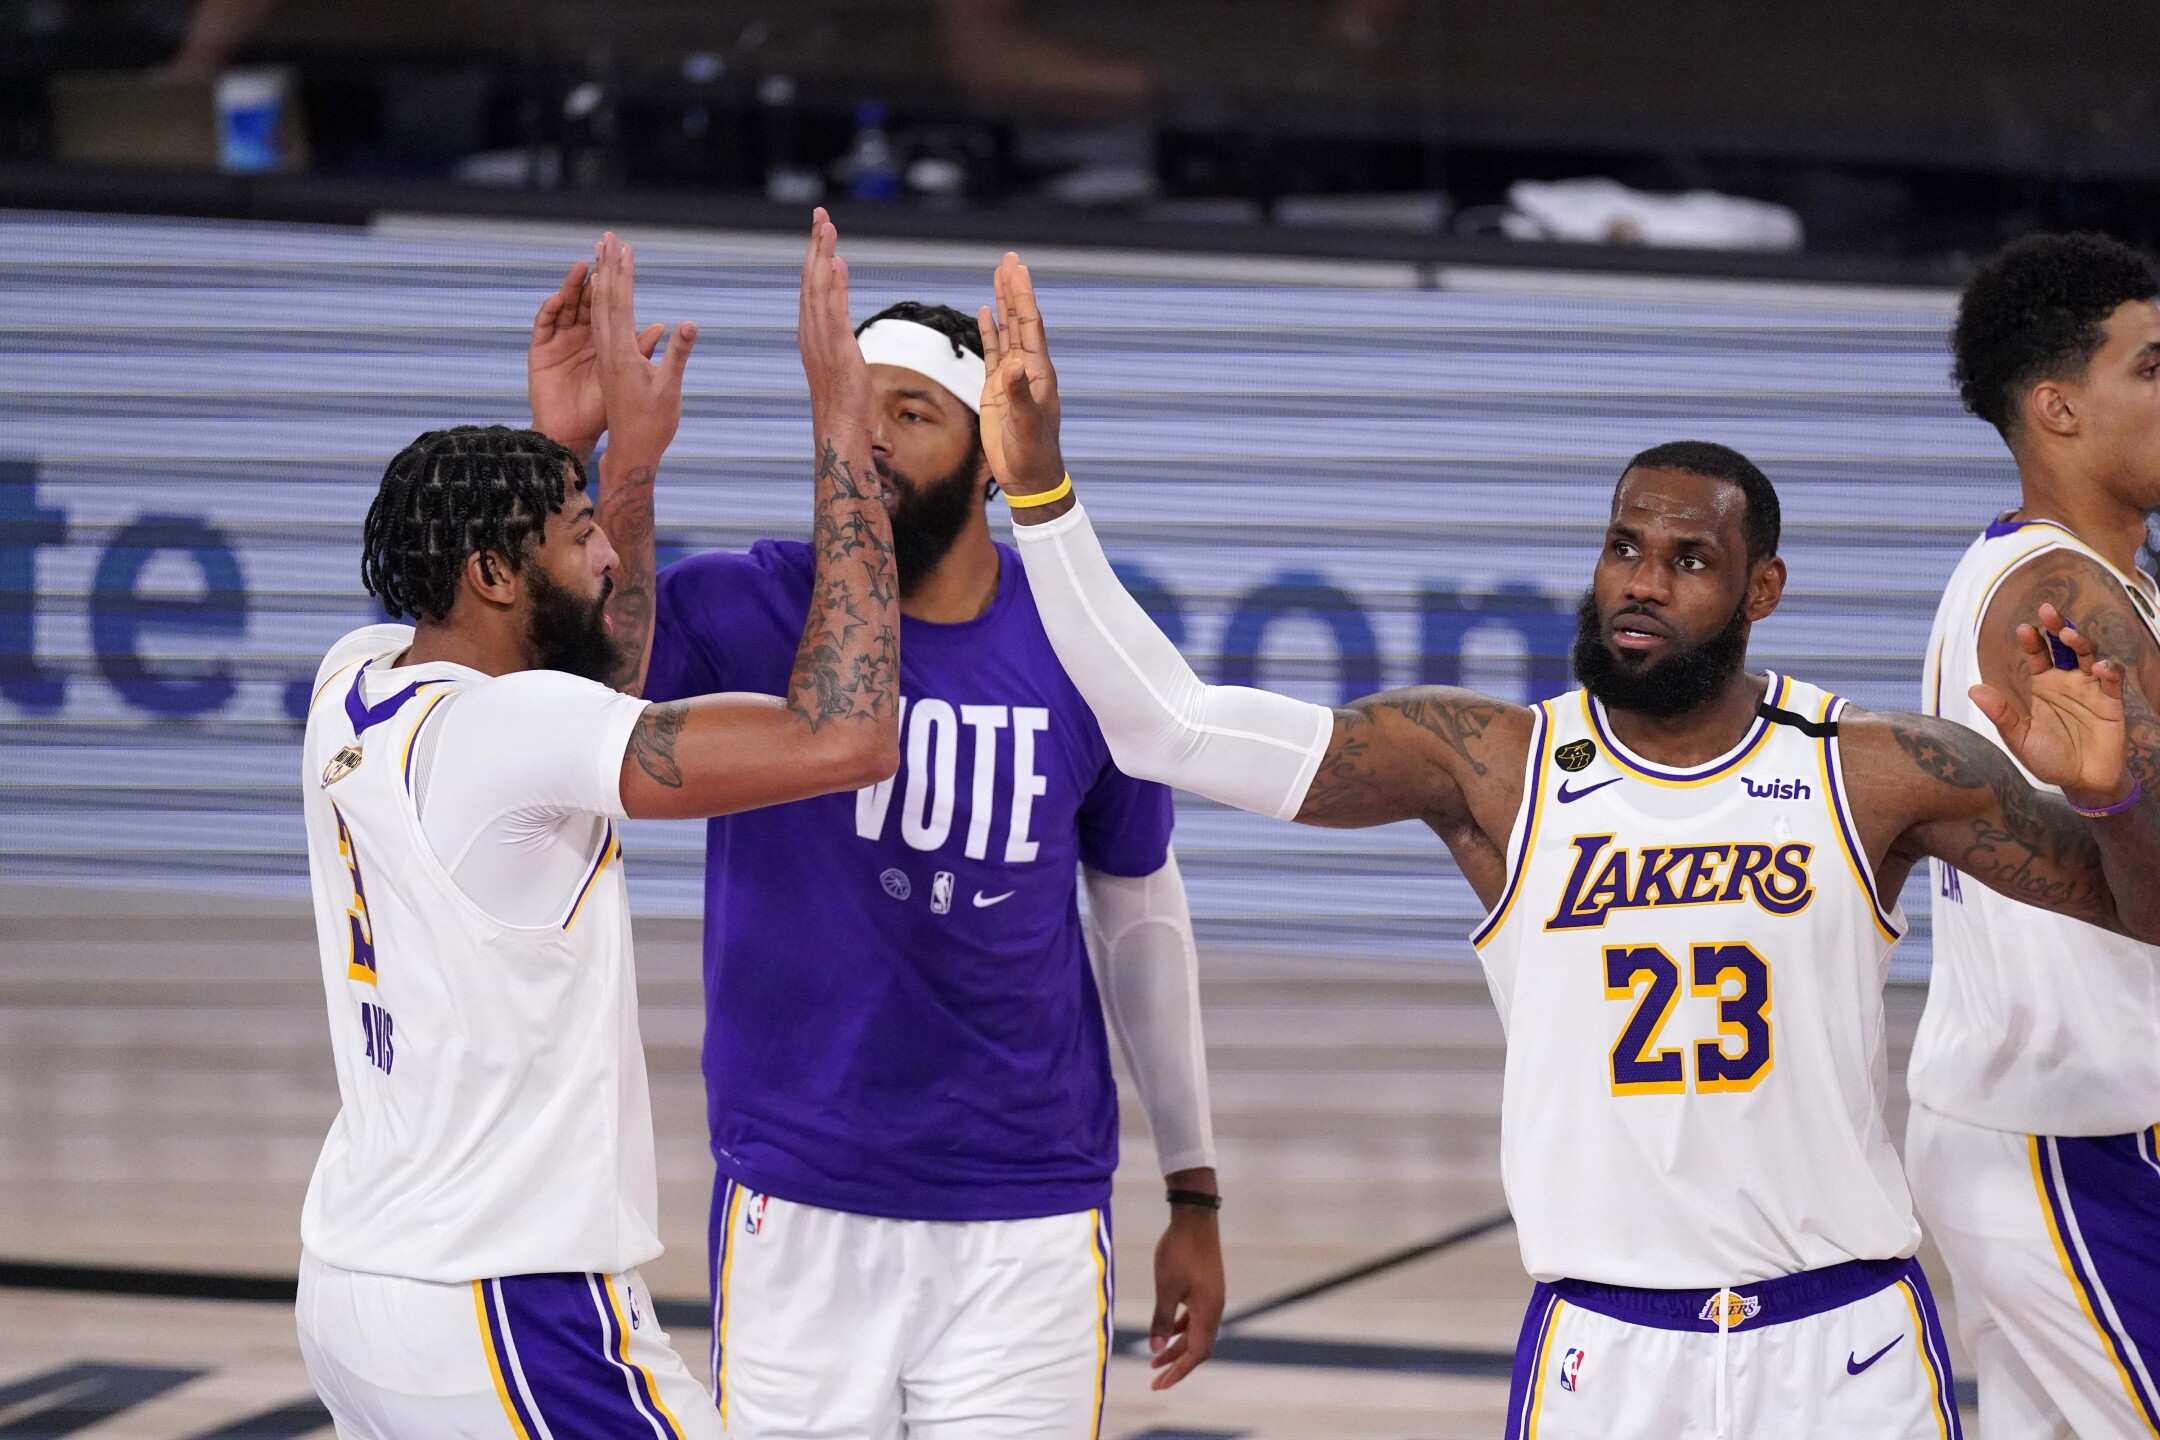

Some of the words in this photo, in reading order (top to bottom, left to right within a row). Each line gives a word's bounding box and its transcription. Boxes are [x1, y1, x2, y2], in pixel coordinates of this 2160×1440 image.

[1741, 776, 1811, 800] wish
[1543, 832, 1816, 933] LAKERS
[361, 1002, 394, 1076] AVIS
[1602, 941, 1774, 1097] 23
[1700, 1300, 1760, 1319] LAERS
